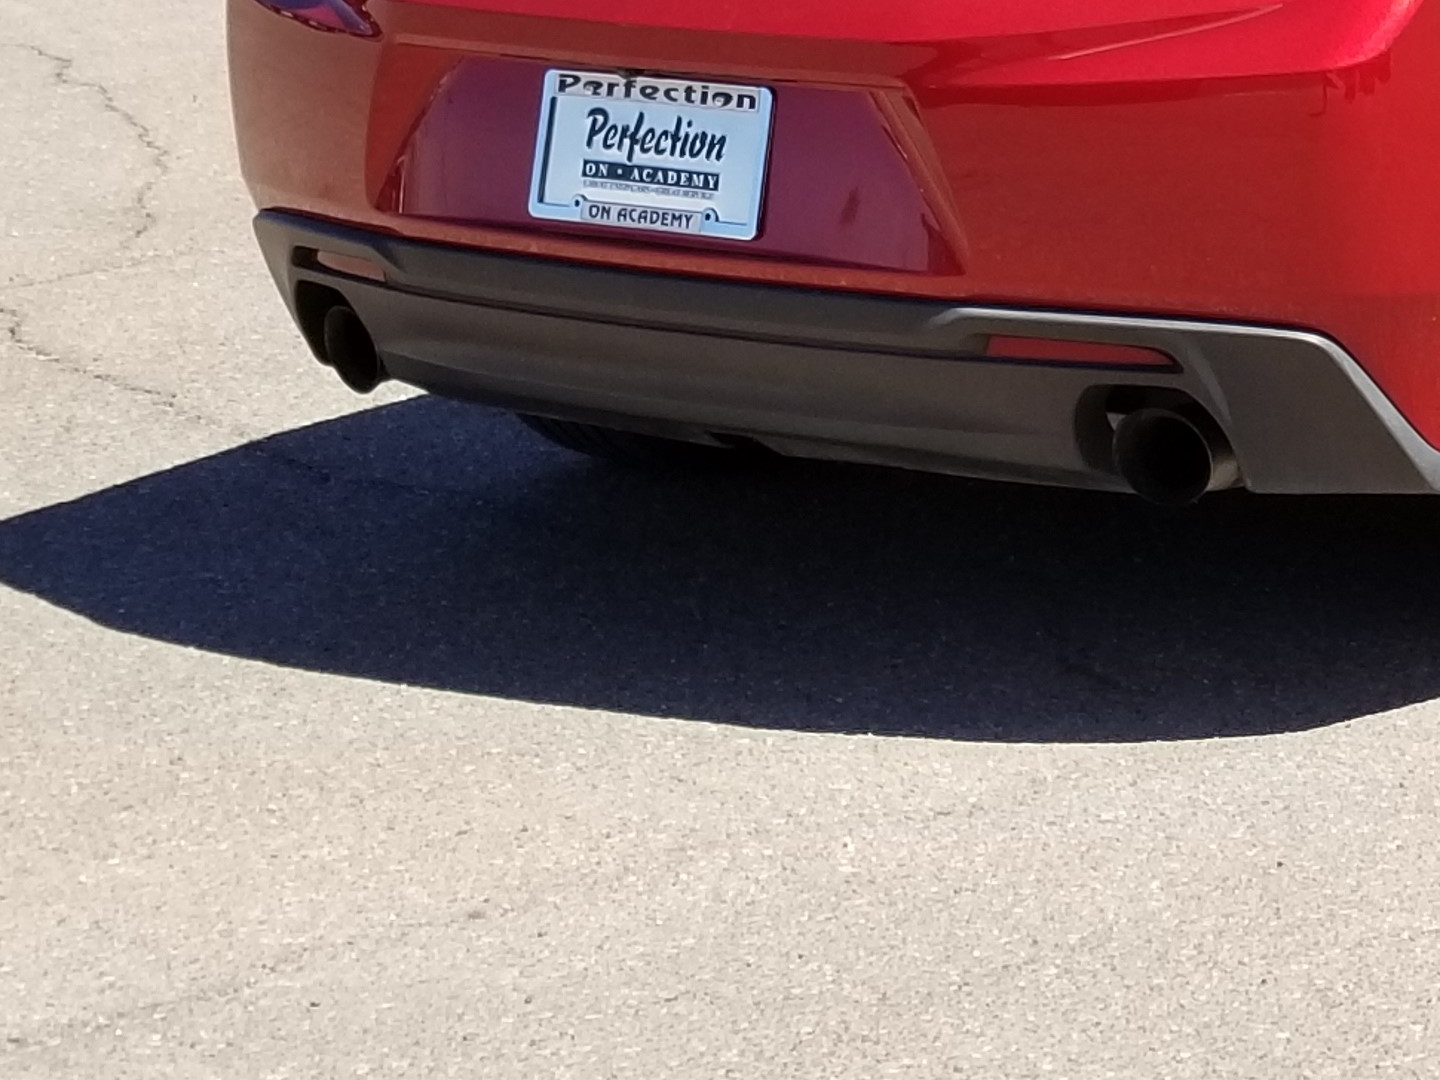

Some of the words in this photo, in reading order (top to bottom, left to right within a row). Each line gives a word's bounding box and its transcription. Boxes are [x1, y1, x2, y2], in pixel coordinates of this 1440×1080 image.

[558, 73, 757, 110] Perfection
[585, 107, 728, 163] Perfection
[585, 163, 609, 177] ON
[630, 167, 718, 189] ACADEMY
[588, 204, 612, 220] ON
[617, 207, 694, 230] ACADEMY
